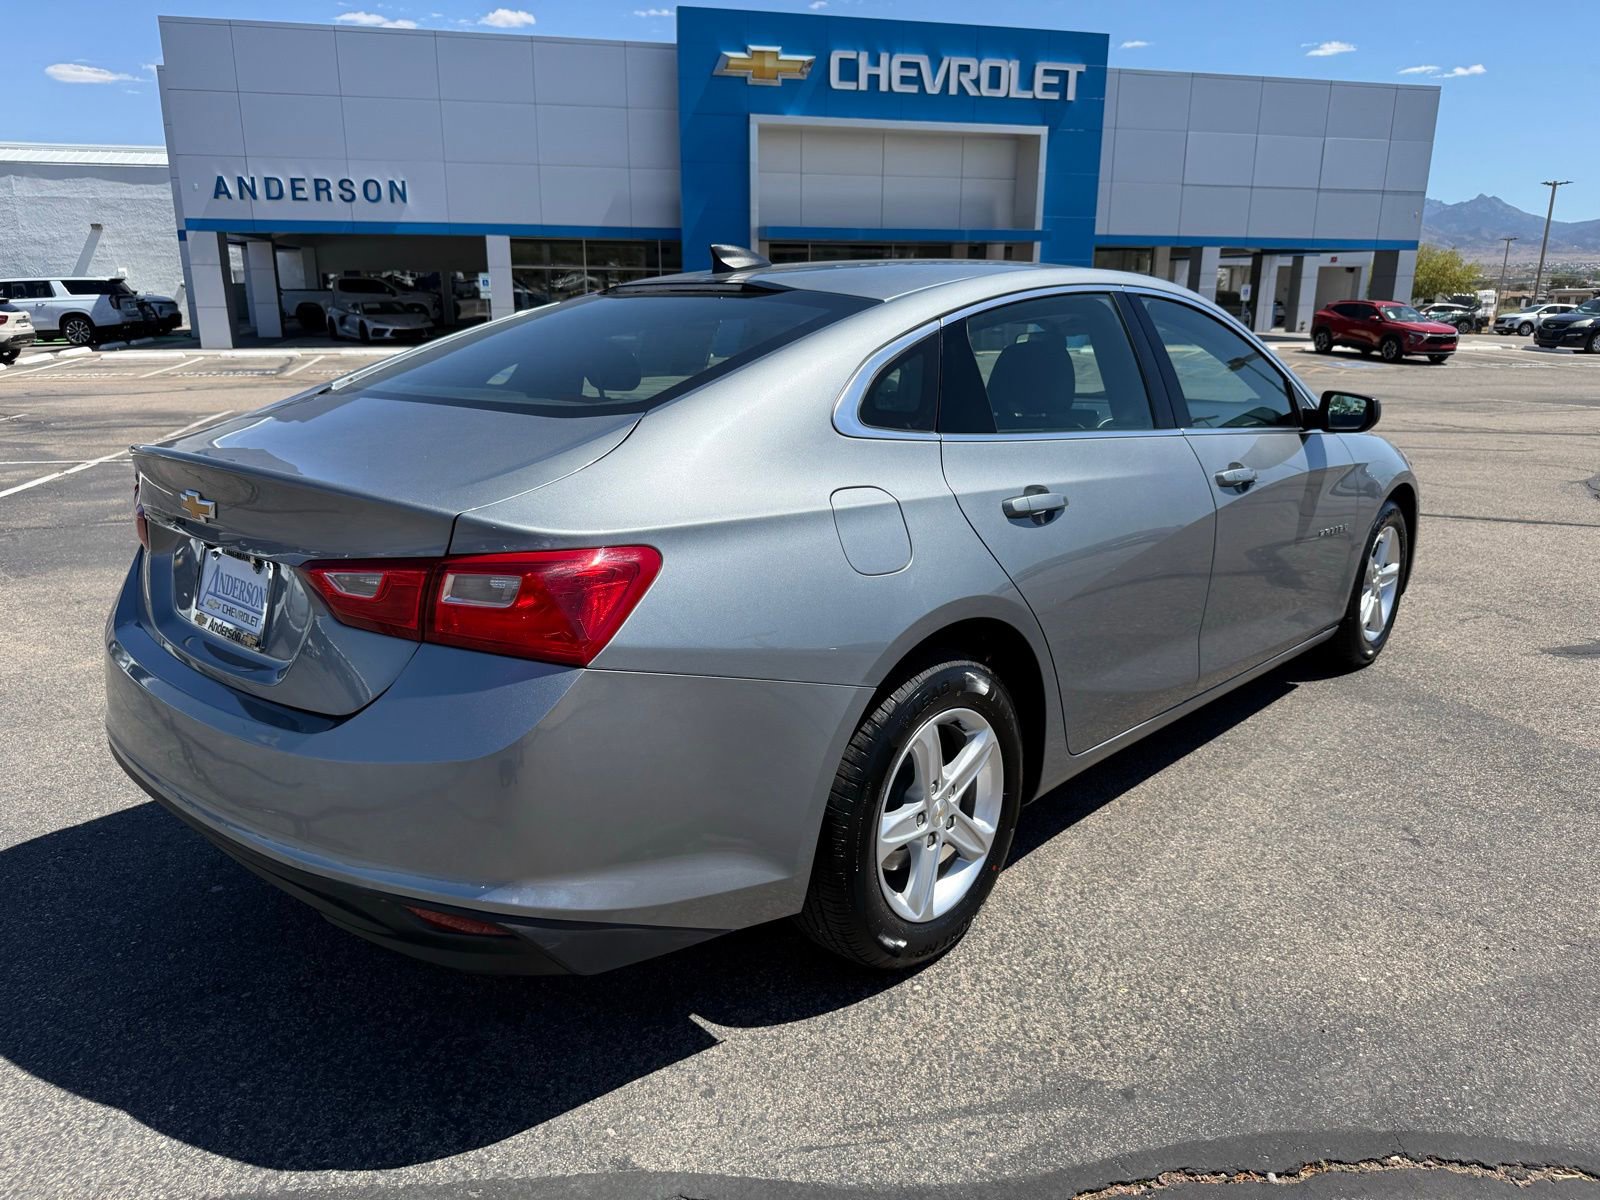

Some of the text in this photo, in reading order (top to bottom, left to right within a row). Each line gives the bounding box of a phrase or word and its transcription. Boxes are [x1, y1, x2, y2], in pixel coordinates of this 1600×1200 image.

[829, 50, 1086, 101] CHEVROLET
[213, 175, 408, 204] ANDERSON
[200, 564, 267, 610] ANDERSON
[207, 617, 242, 642] Anderson
[222, 604, 259, 627] CHEVROLET
